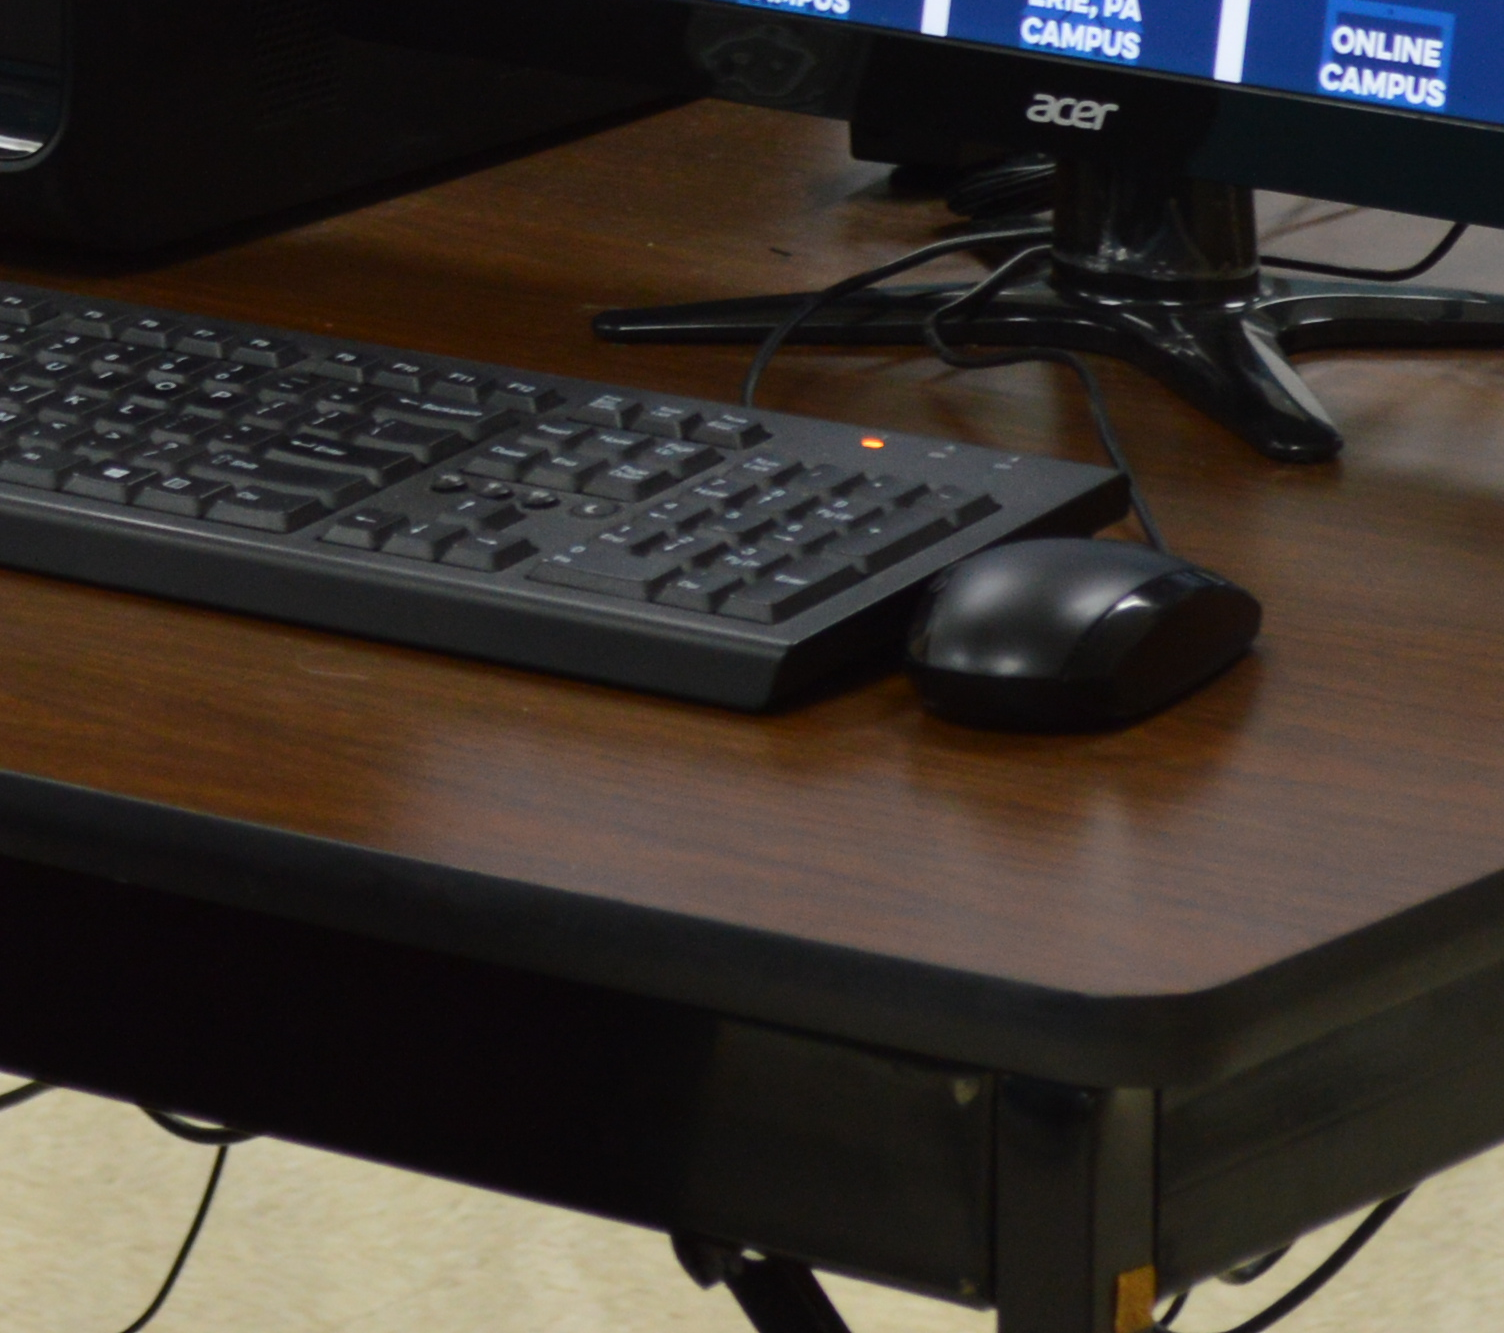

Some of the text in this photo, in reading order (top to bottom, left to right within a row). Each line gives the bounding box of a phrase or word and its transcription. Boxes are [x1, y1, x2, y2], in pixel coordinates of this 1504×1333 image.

[1020, 17, 1141, 61] CAMPUS
[1331, 25, 1443, 70] ONLINE
[1318, 63, 1447, 110] CAMPUS
[1026, 92, 1120, 132] acer
